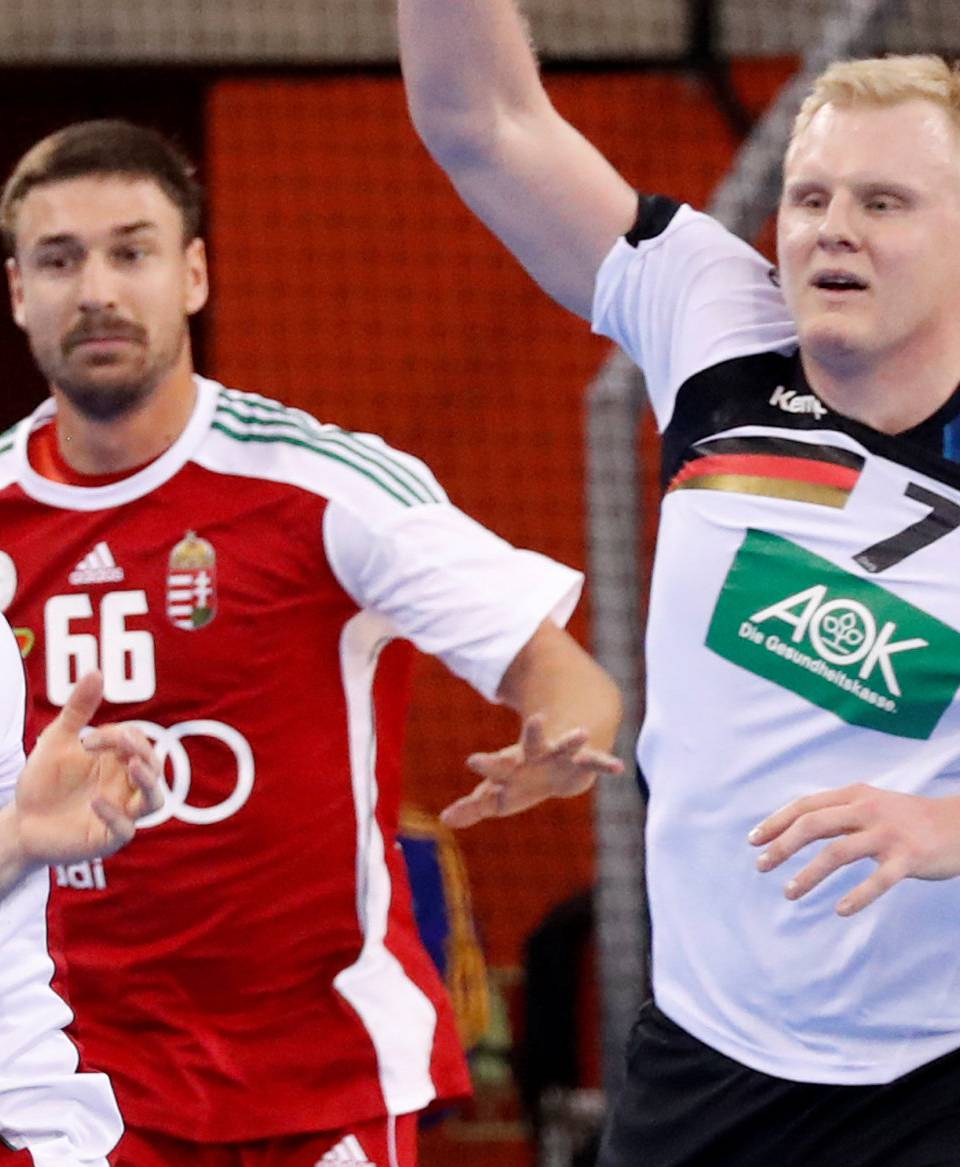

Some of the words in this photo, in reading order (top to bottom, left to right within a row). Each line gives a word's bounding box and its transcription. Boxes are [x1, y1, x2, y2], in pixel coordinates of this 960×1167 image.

[852, 481, 960, 574] 7
[43, 589, 157, 707] 66
[738, 622, 765, 645] Die
[765, 635, 897, 714] Gesundheitskasse.
[749, 584, 929, 698] AOK
